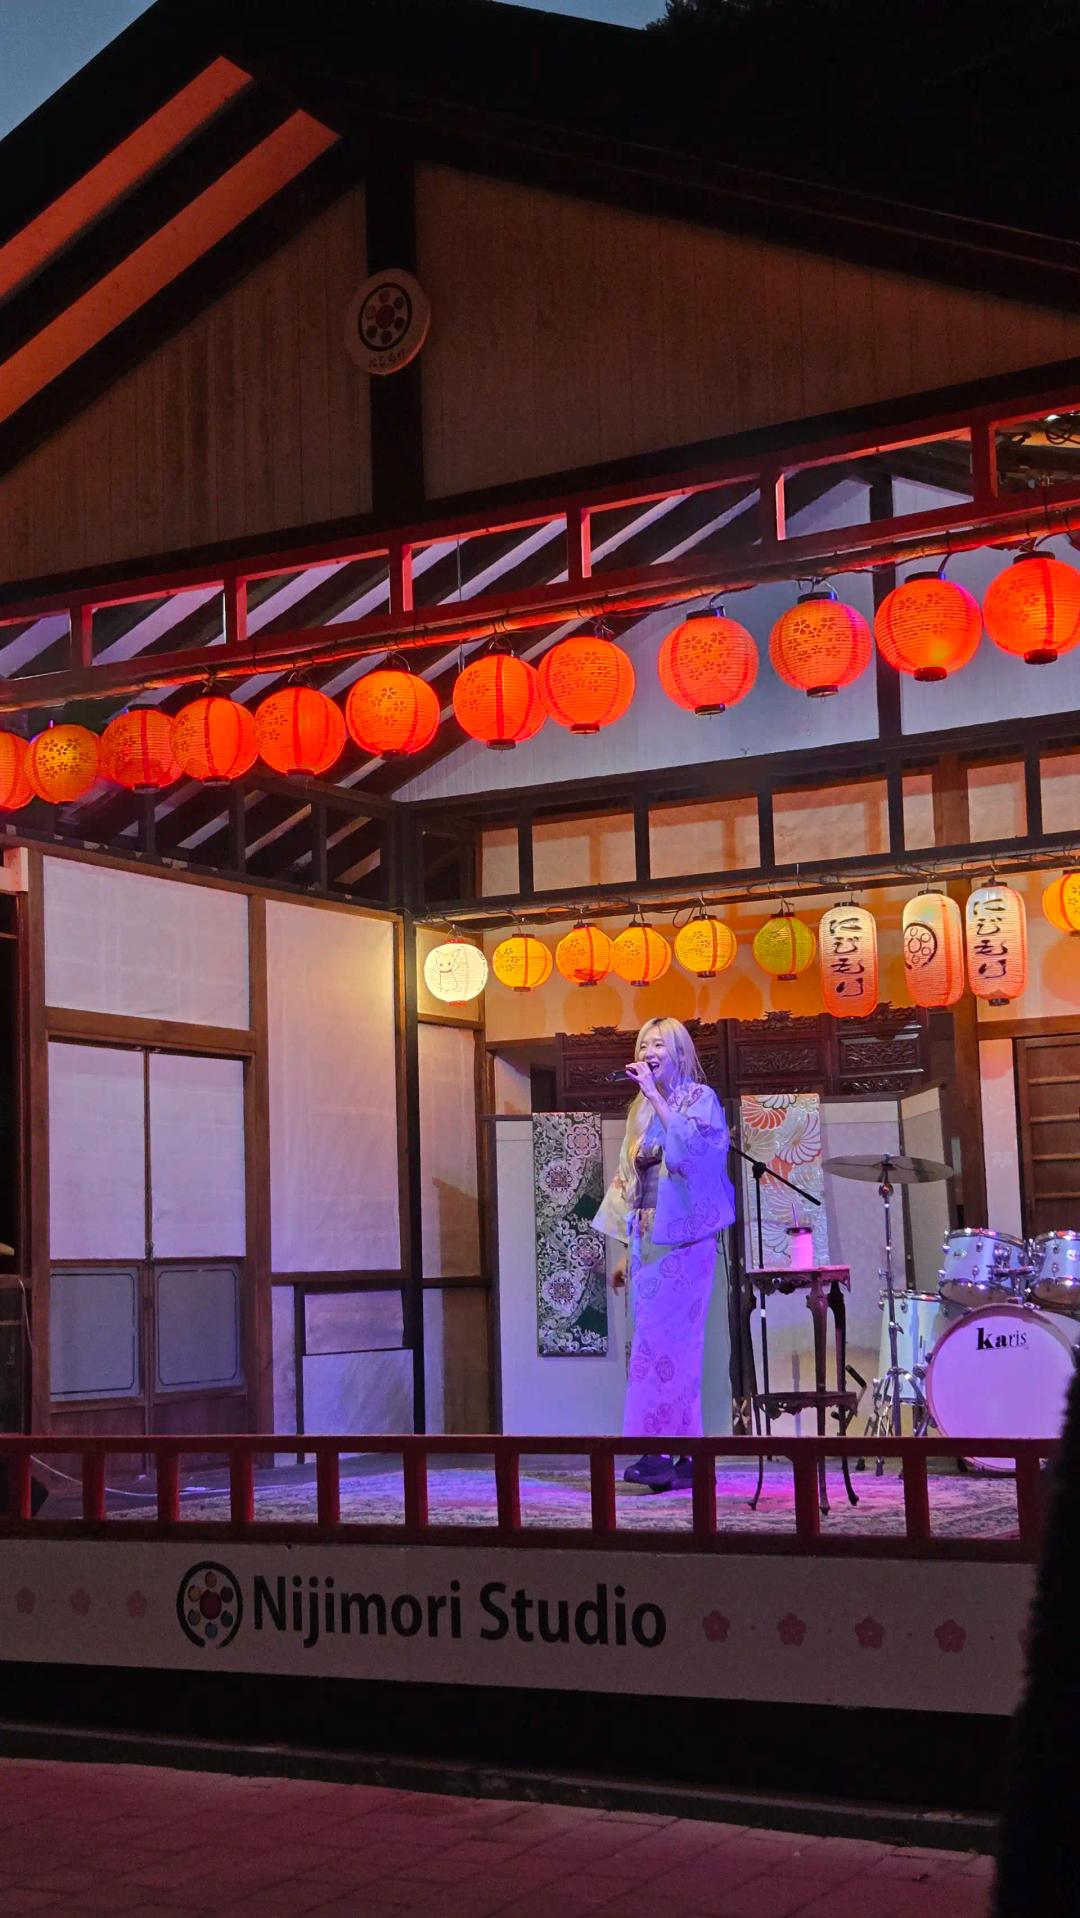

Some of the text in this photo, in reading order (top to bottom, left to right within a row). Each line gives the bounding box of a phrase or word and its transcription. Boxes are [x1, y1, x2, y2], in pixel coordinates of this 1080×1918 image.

[977, 1328, 1027, 1350] karis
[254, 1576, 667, 1648] Nijimori Studio
